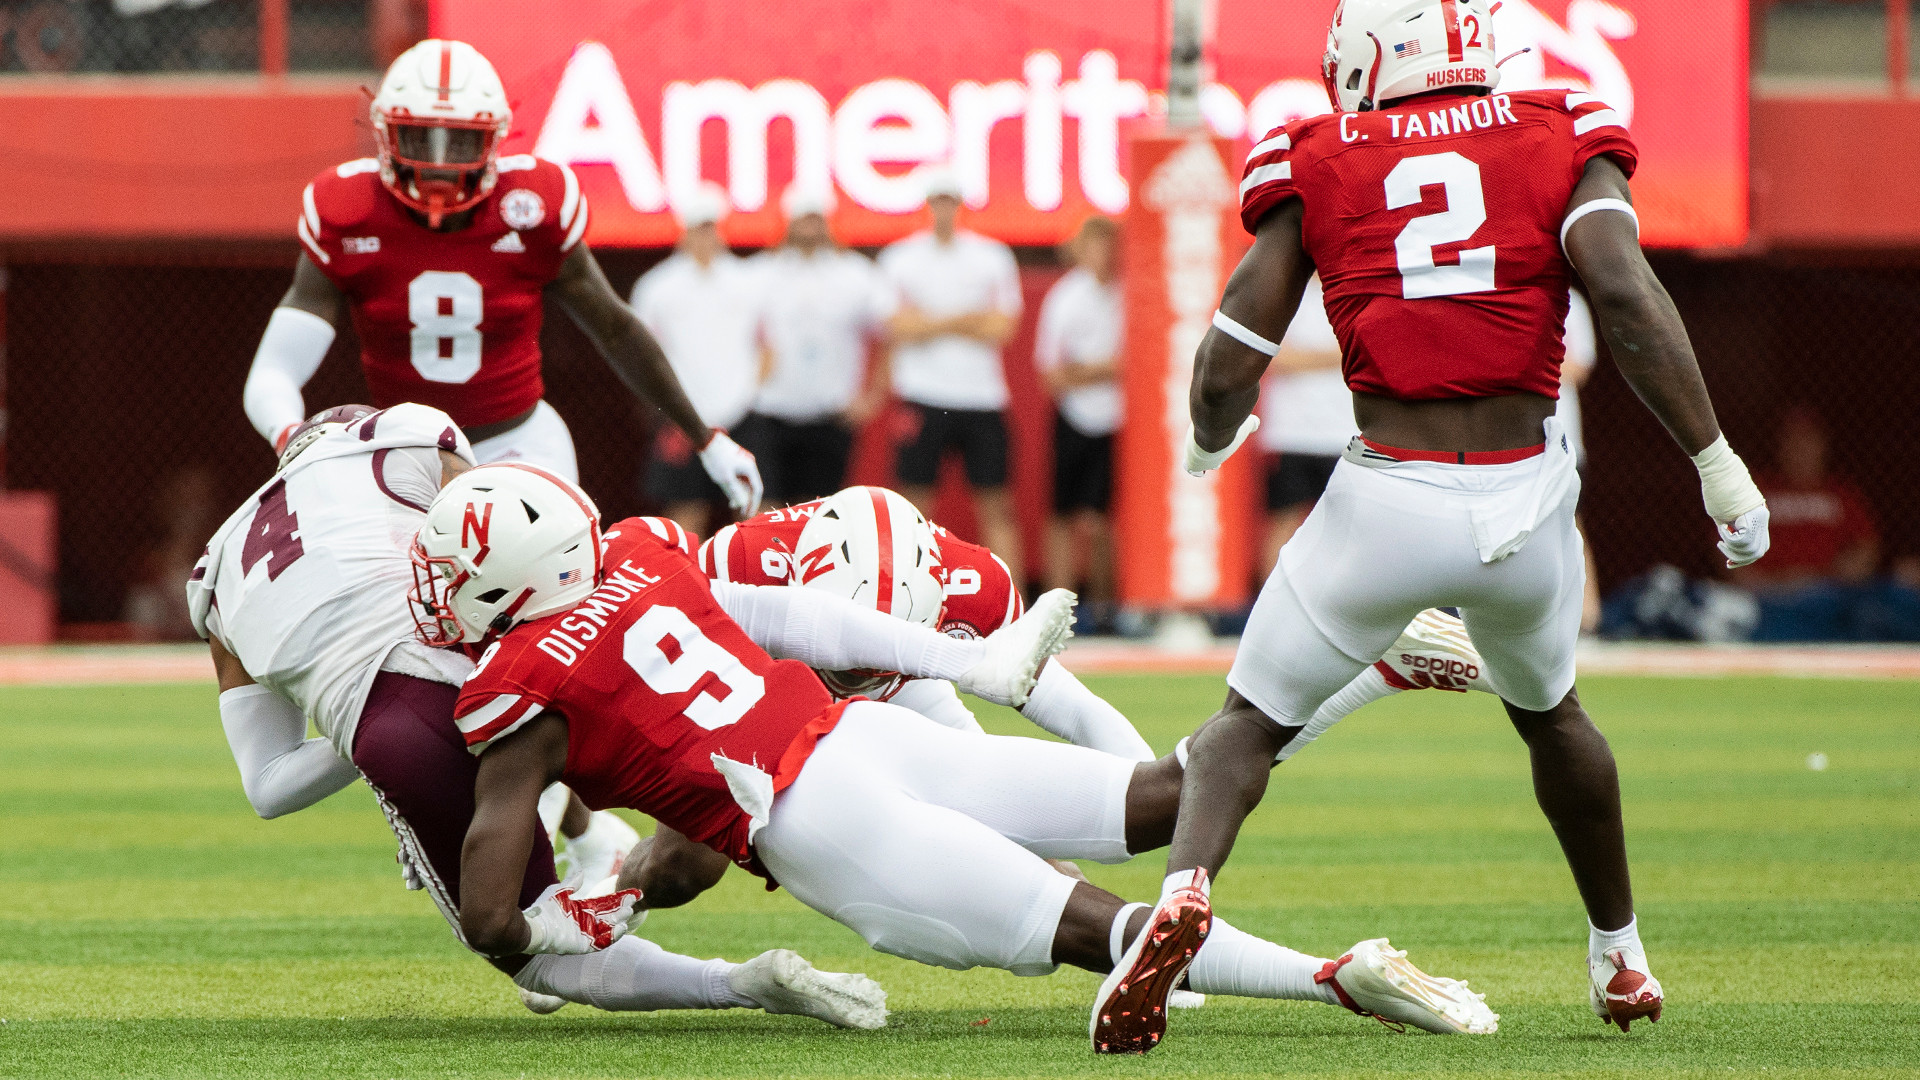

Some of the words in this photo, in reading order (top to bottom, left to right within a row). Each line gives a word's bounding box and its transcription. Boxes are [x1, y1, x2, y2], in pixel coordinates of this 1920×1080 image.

[1464, 15, 1481, 48] 2
[1426, 67, 1487, 87] HUSKERS
[534, 41, 1334, 213] Amerit
[1339, 112, 1369, 142] C.
[1386, 94, 1519, 138] TANNOR
[1384, 152, 1496, 299] 2
[408, 271, 484, 384] 8
[241, 477, 305, 583] 4
[461, 502, 493, 549] N
[800, 543, 835, 586] N
[536, 559, 662, 667] DISMUKE
[623, 604, 766, 731] 9
[1401, 653, 1479, 680] adidas
